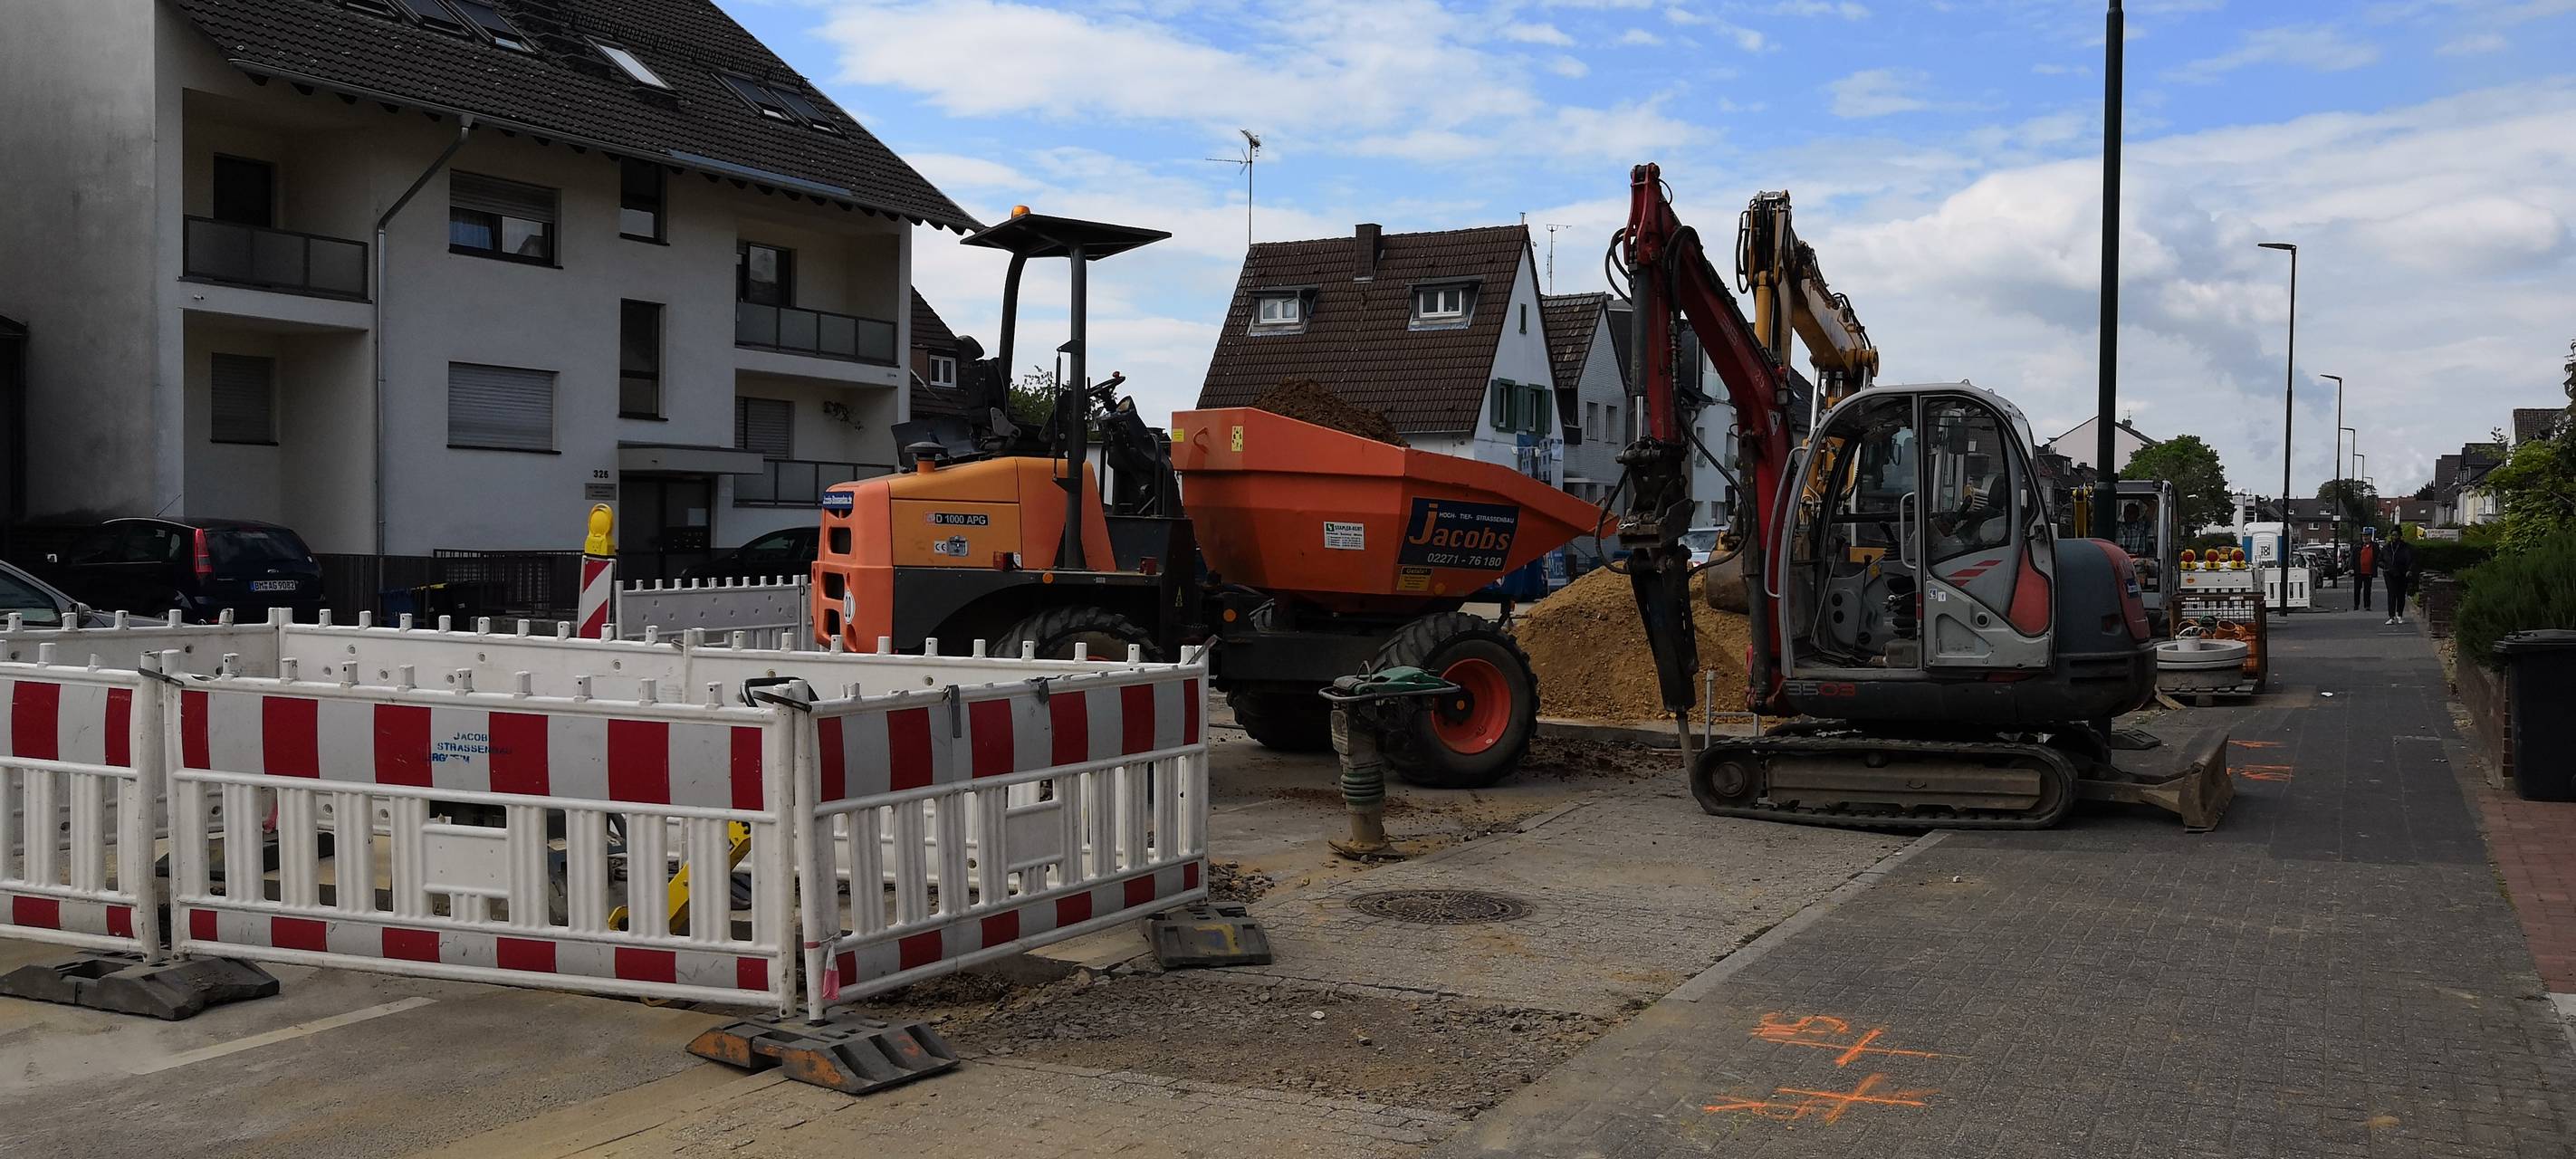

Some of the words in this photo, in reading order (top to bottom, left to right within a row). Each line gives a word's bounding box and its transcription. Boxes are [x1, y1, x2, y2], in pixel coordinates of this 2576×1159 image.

[935, 513, 943, 523] D
[945, 514, 964, 524] 1000
[966, 515, 986, 525] APG
[1475, 514, 1514, 524] STRASSENBAU
[1427, 552, 1460, 564] 02271
[1468, 555, 1482, 566] 76
[1484, 556, 1502, 567] 180
